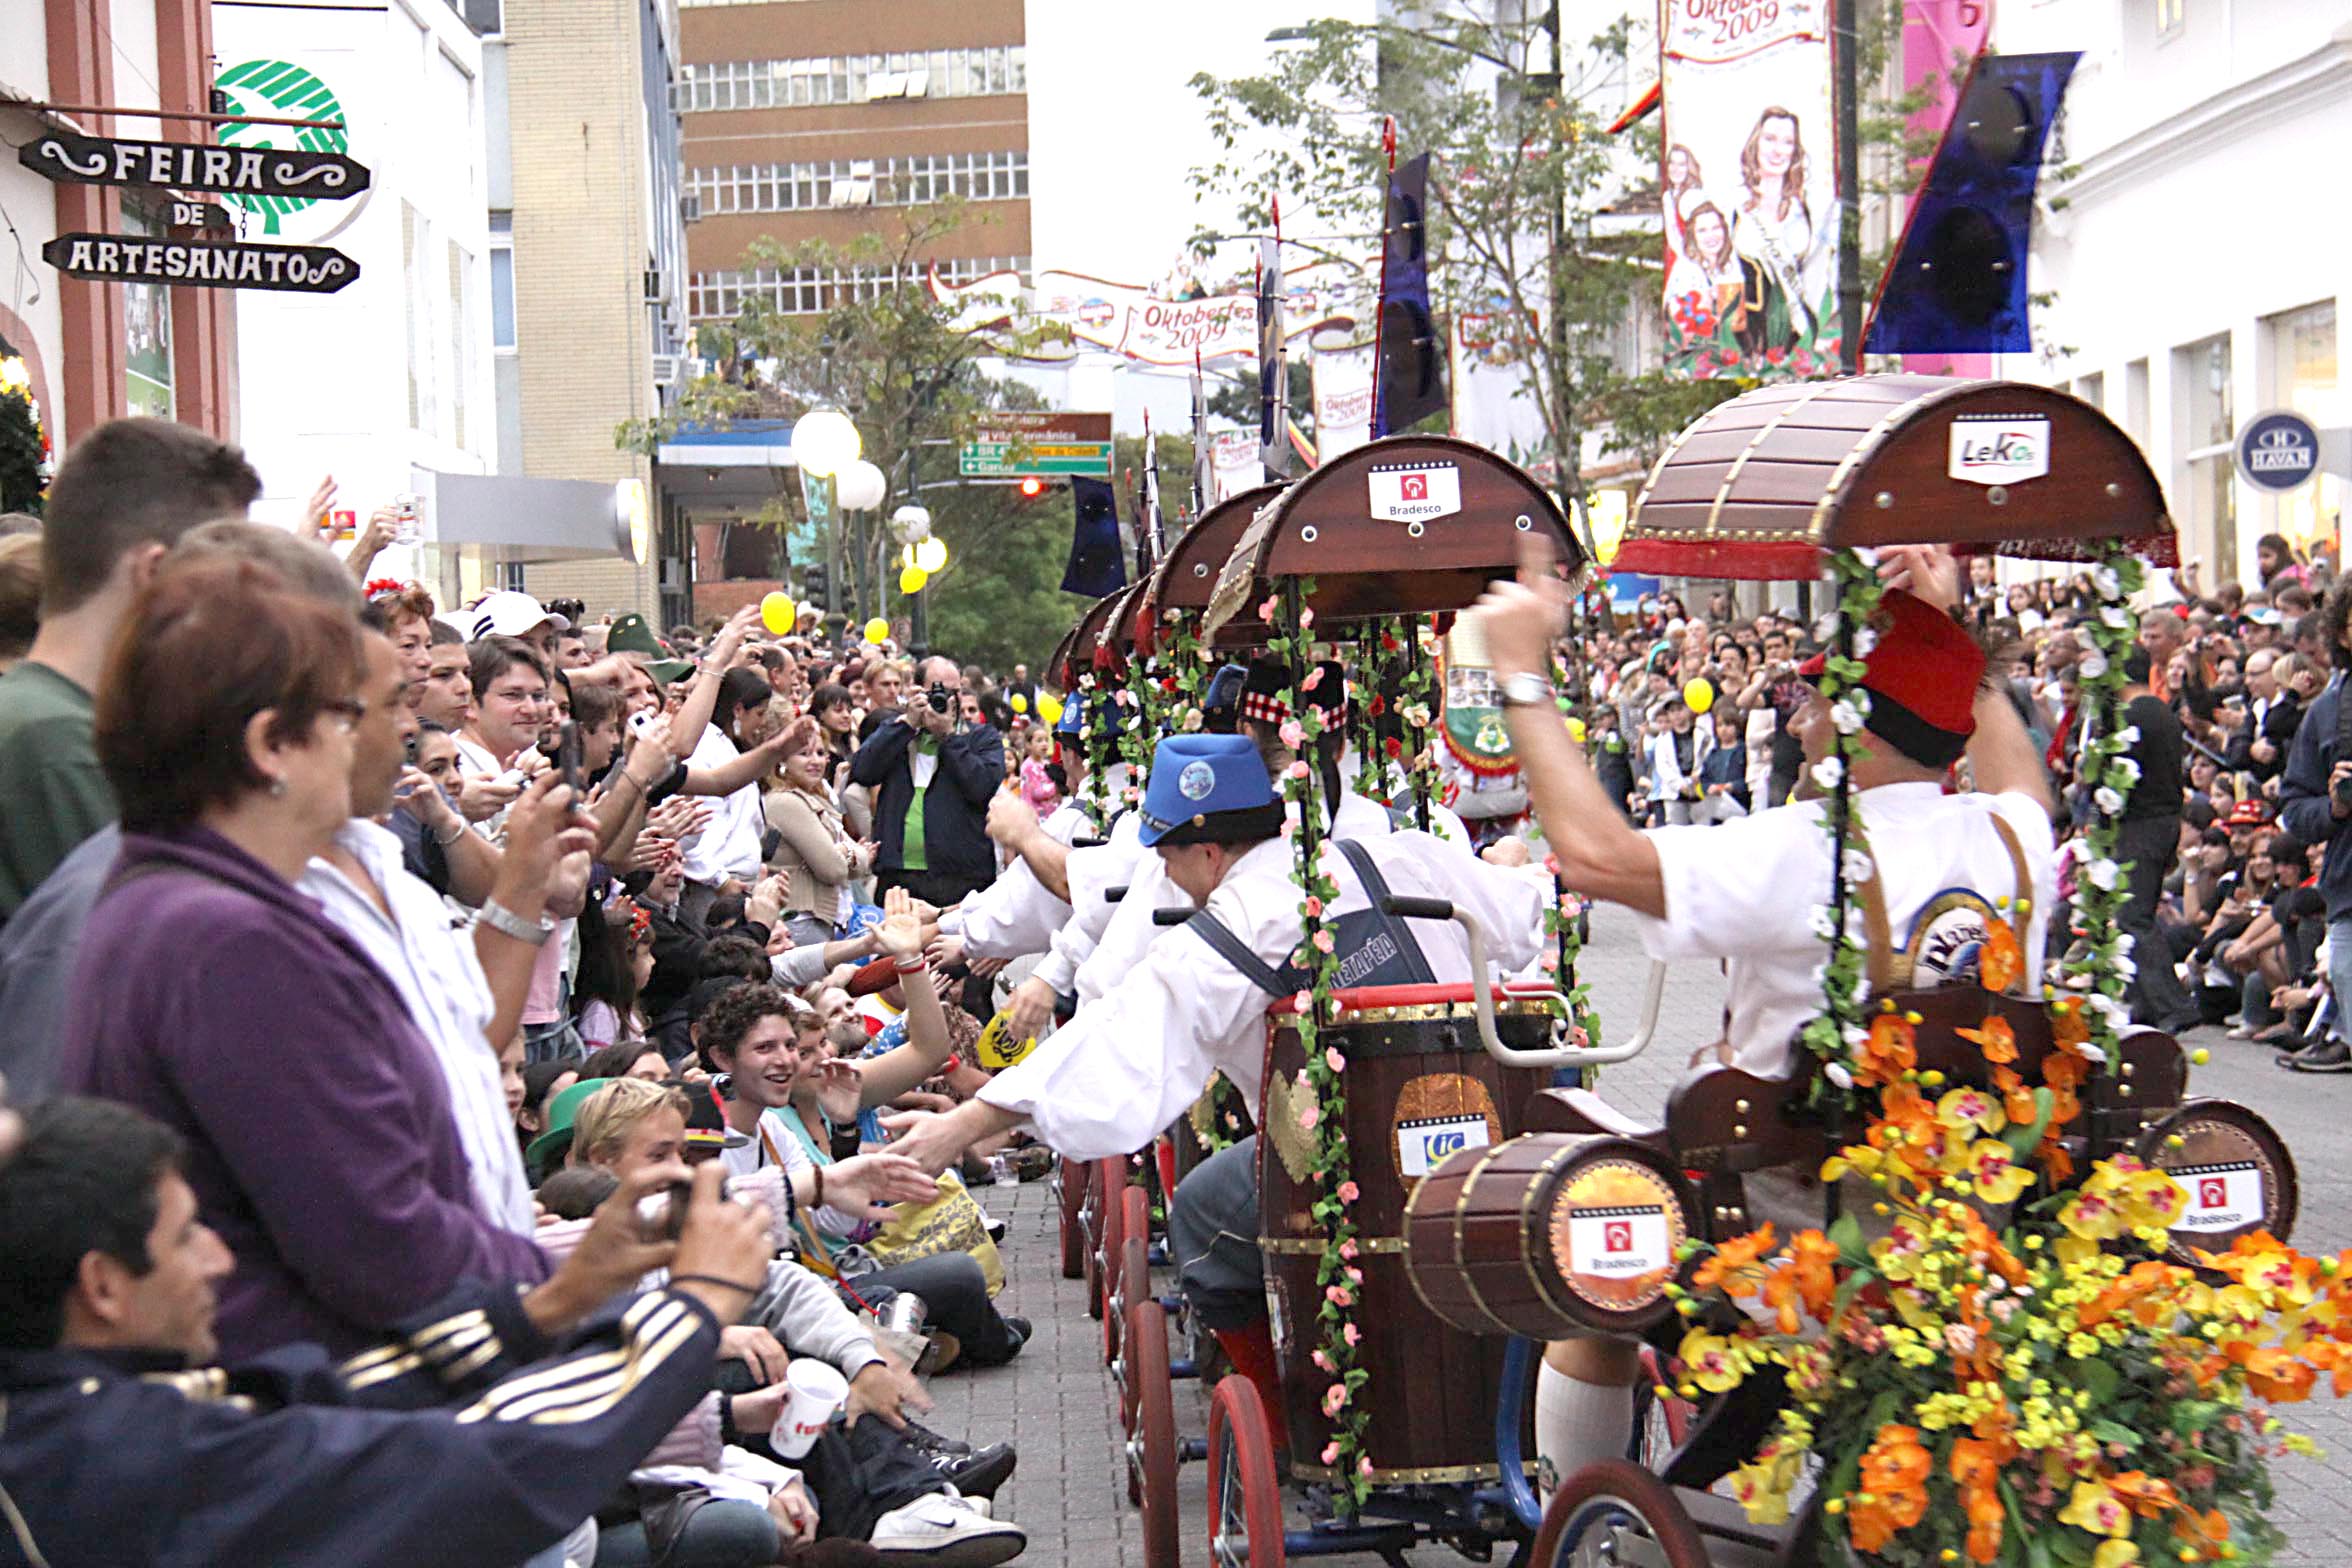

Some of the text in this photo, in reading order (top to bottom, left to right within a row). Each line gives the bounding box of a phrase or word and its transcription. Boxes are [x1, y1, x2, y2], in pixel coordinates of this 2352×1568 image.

[1687, 0, 1763, 18] Okto
[1712, 2, 1779, 44] 2009
[112, 143, 265, 189] FEIRA
[173, 203, 205, 227] DE
[67, 240, 309, 284] ARTESANATO
[1144, 300, 1255, 329] Oktoberfes
[1165, 319, 1228, 350] 2009
[2251, 446, 2311, 471] HAVAN
[1389, 504, 1442, 516] Bradesco
[2186, 1213, 2243, 1226] Bradesco
[1591, 1258, 1649, 1270] Bradesco
